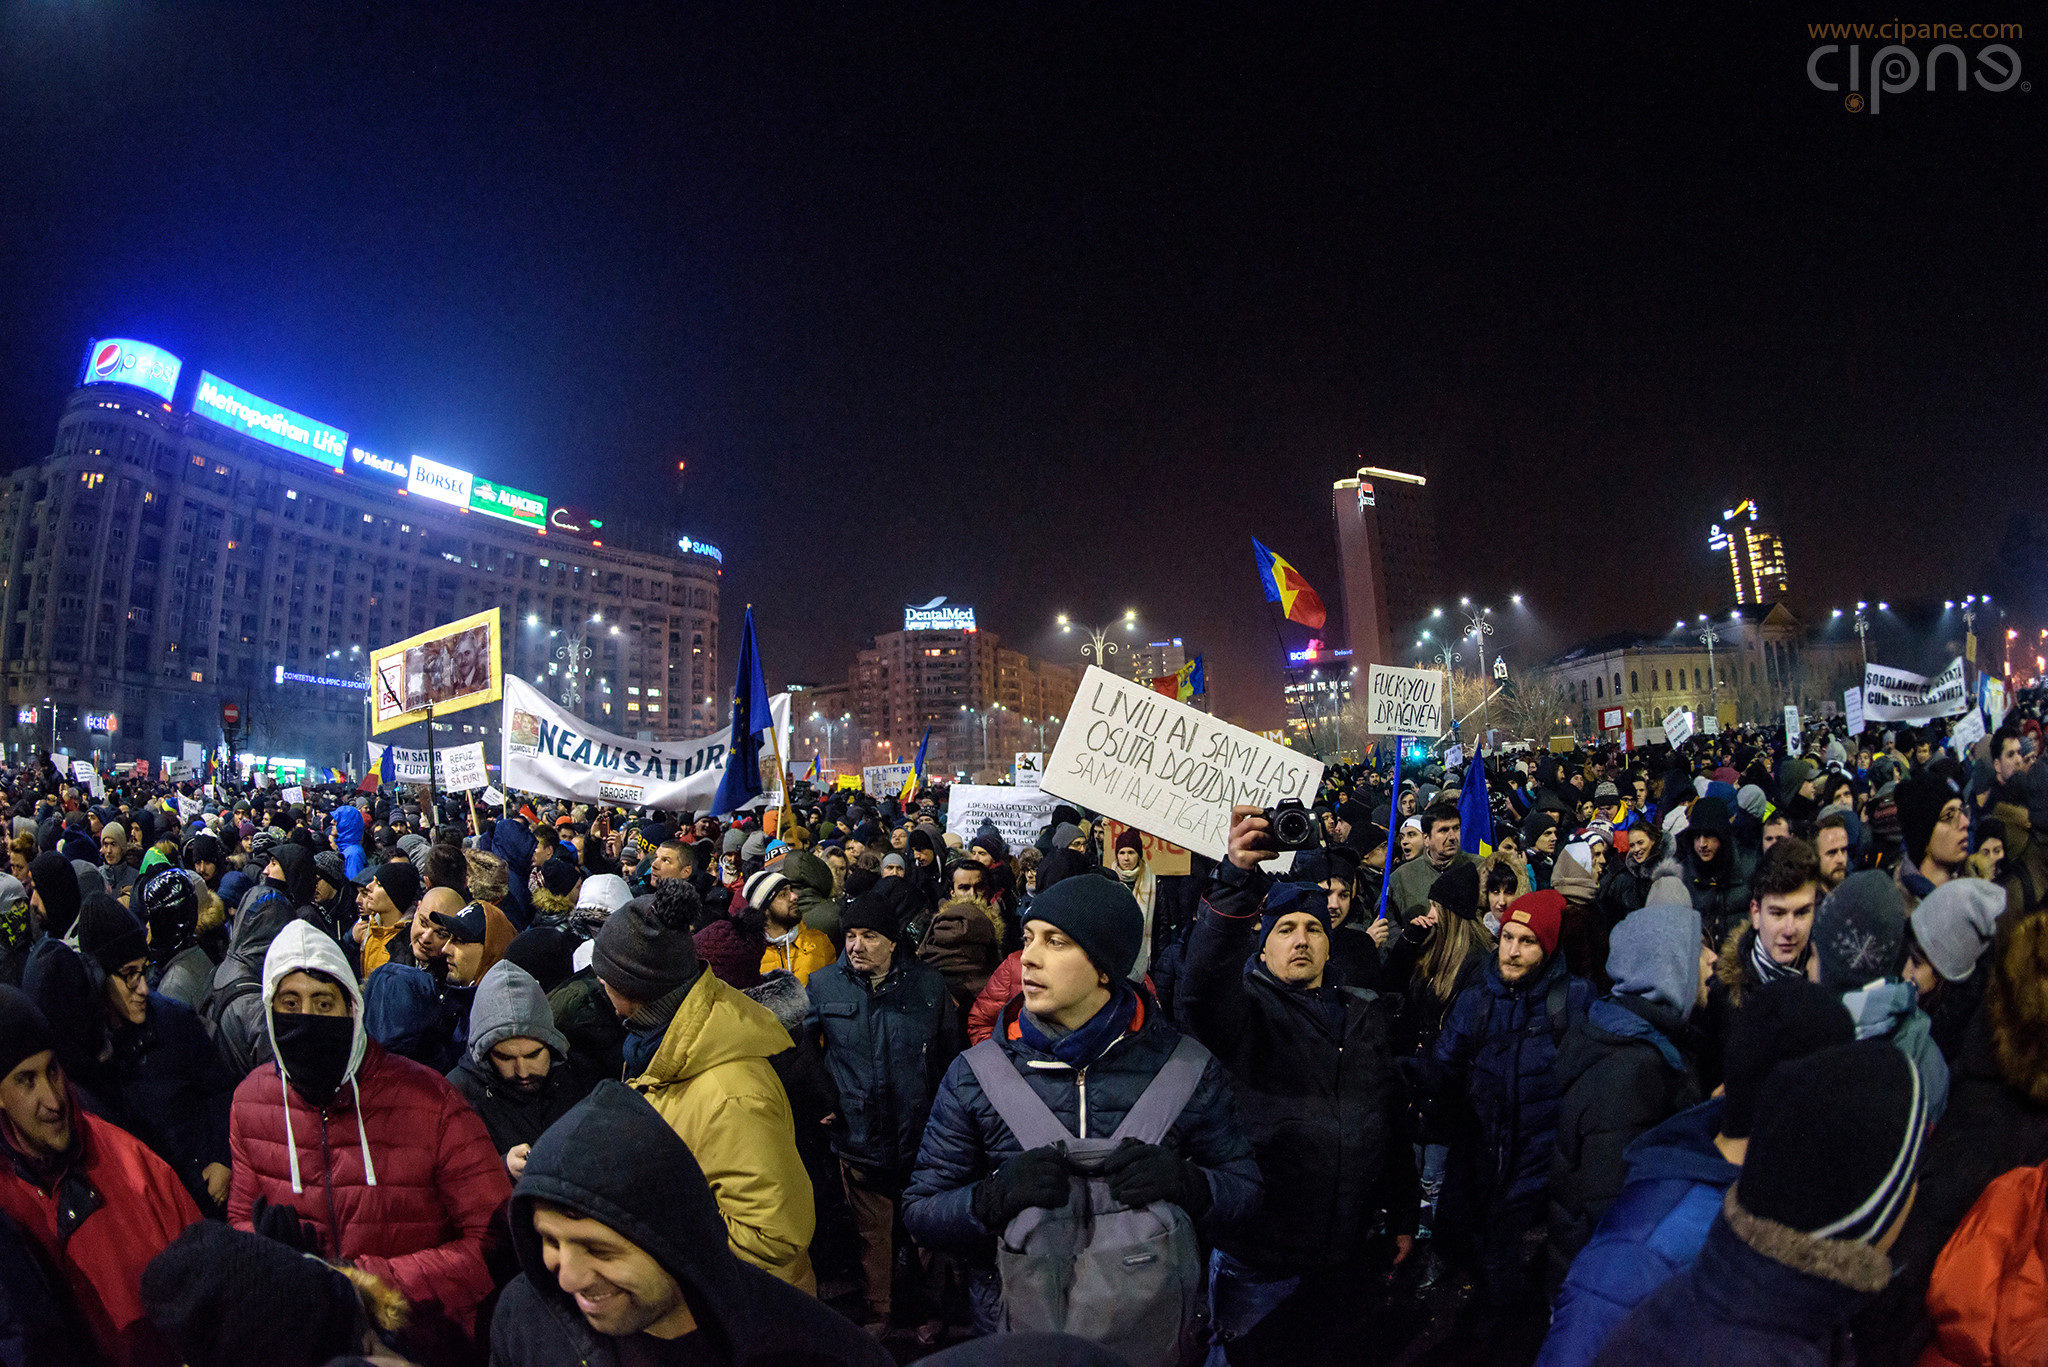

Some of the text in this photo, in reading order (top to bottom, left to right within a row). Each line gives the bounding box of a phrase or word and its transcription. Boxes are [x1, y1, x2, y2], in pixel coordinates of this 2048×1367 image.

[198, 382, 345, 457] Metropolitan Life
[905, 608, 973, 621] DentalMed
[317, 676, 341, 687] OLIMPIC
[1373, 672, 1436, 704] FUCK YOU
[1867, 691, 1889, 706] CUM
[1166, 715, 1199, 753] AI
[450, 750, 474, 764] REFUZ
[599, 786, 638, 801] ABROGARE
